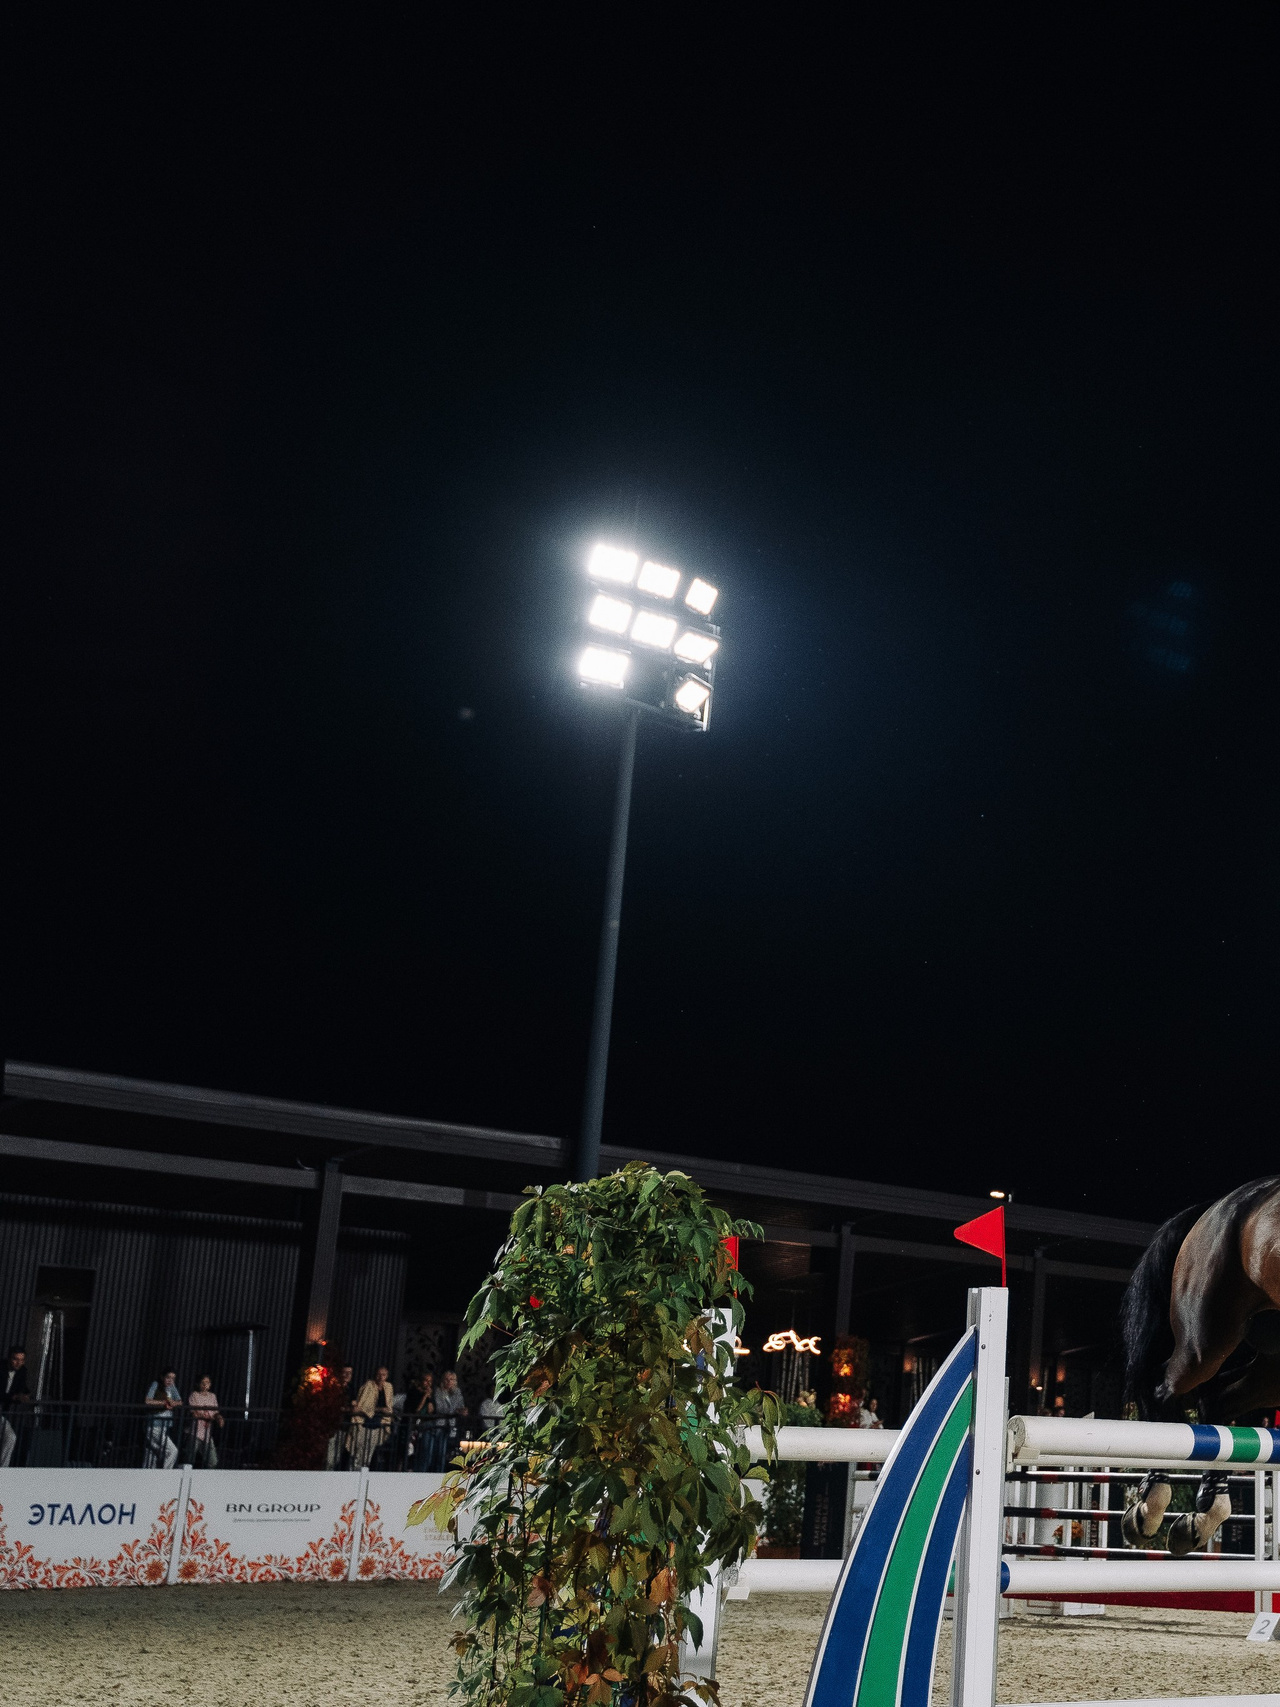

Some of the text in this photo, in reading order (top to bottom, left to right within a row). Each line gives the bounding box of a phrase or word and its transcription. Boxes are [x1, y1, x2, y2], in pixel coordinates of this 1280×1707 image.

[28, 1503, 136, 1525] ЭТАЛОН
[226, 1503, 321, 1512] BN GROUP
[1256, 1619, 1270, 1635] 2
